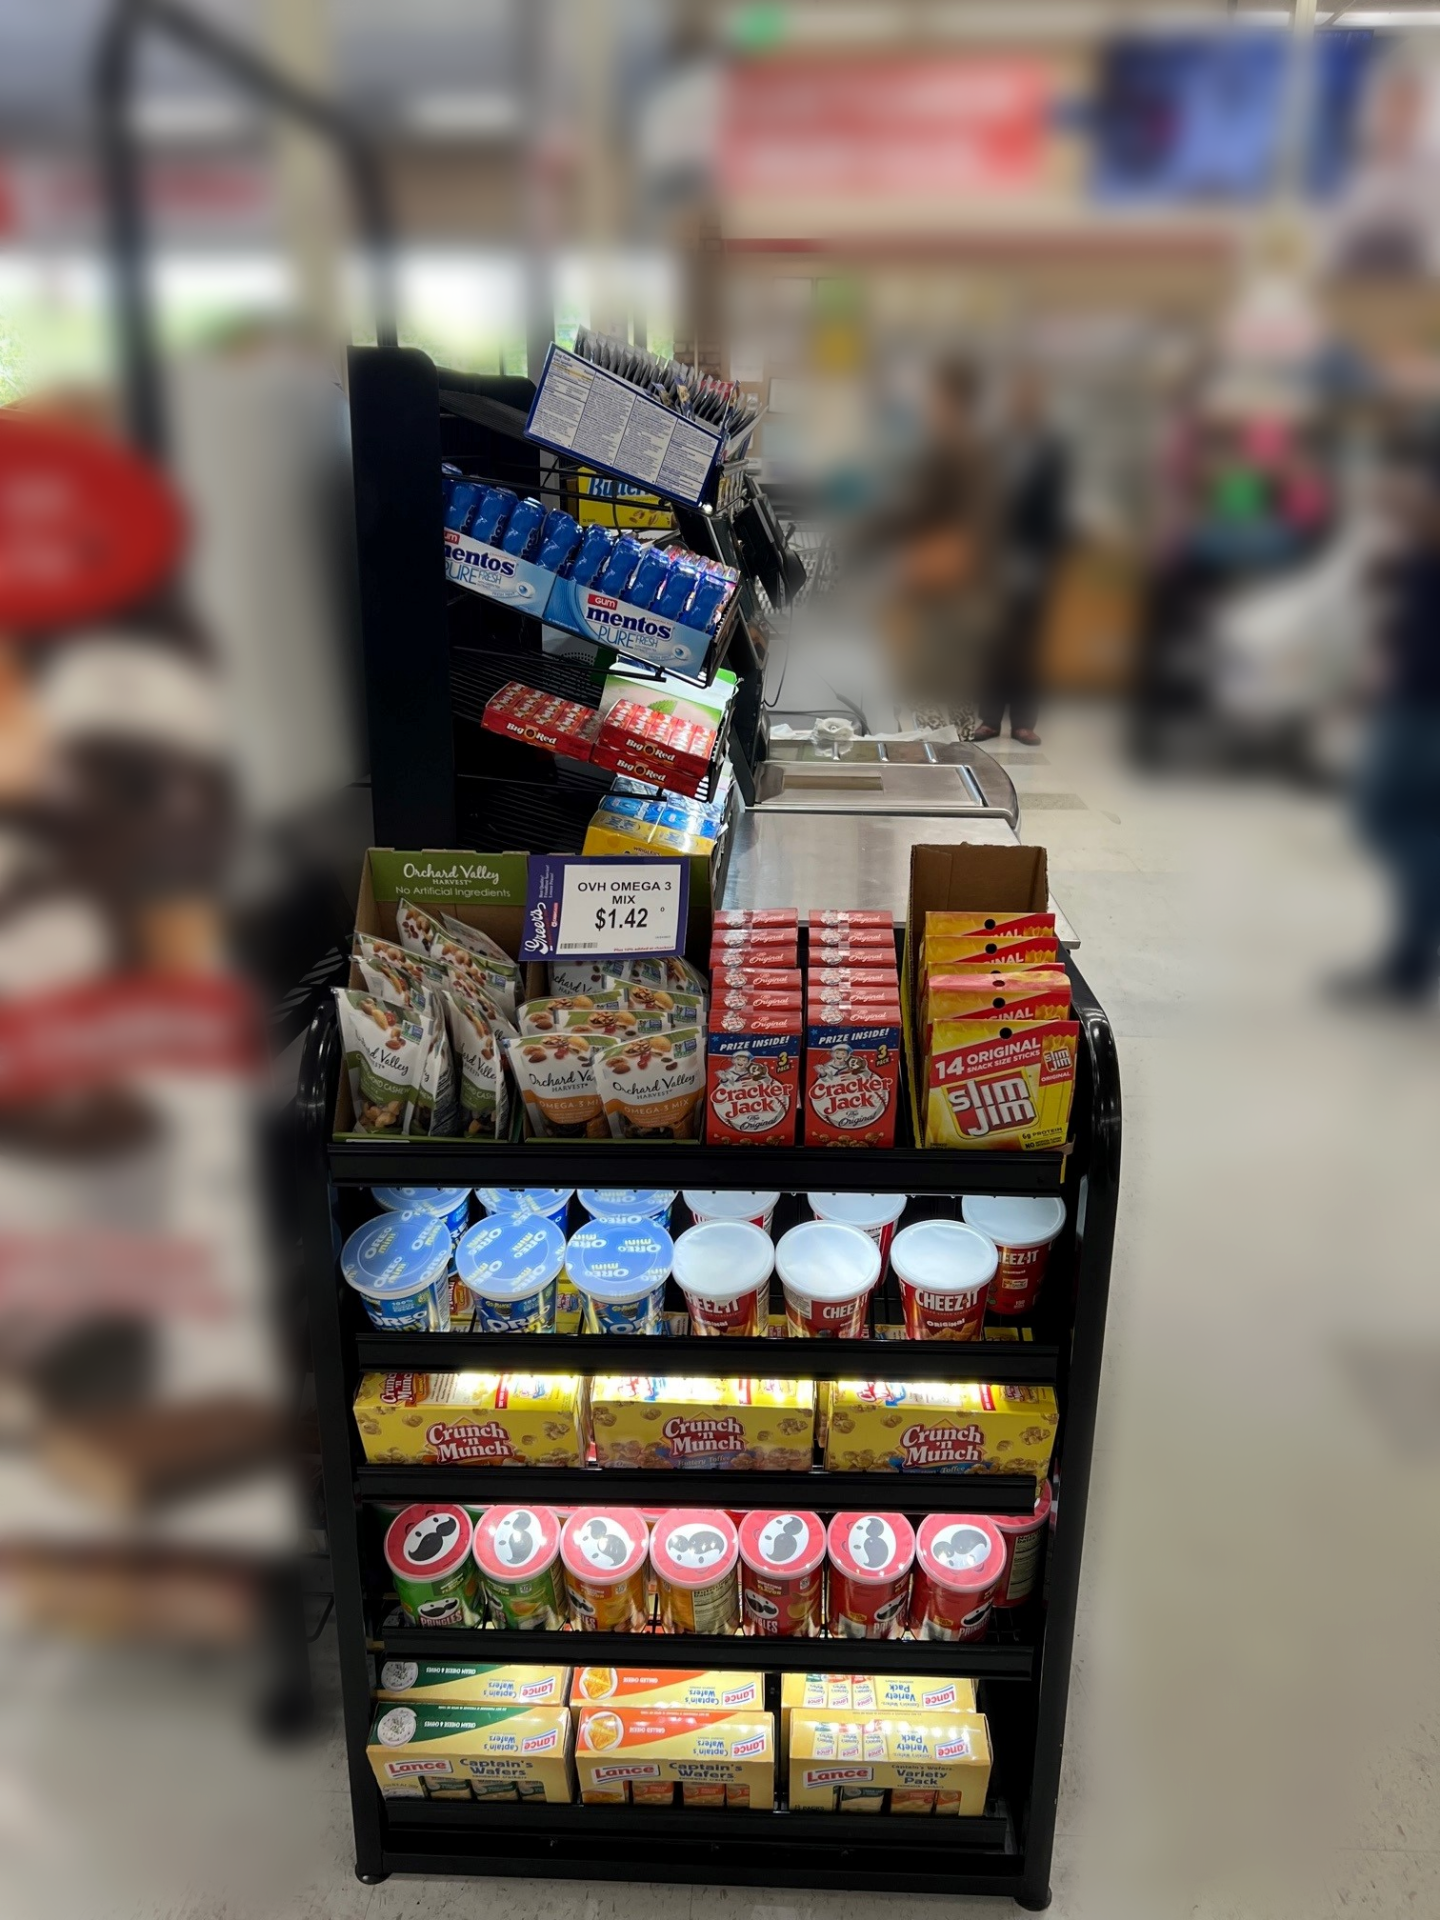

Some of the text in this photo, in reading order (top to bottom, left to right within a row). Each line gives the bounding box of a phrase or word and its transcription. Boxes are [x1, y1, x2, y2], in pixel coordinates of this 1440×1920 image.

[478, 571, 502, 584] FRESH
[586, 606, 671, 639] mentos
[599, 626, 658, 649] PURE FRESH
[506, 722, 557, 745] Big Red
[626, 738, 676, 761] Big Red
[616, 759, 666, 782] Big Red
[403, 863, 500, 885] Orchard Valley
[396, 886, 511, 898] No Artificial Ingredients
[578, 882, 672, 892] OVH OMEGA 3
[612, 895, 636, 904] MIX
[595, 907, 649, 931] $1.42
[524, 902, 549, 955] Greer's
[753, 975, 788, 985] Original
[849, 974, 884, 982] Original
[753, 997, 789, 1007] Original
[850, 992, 885, 1002] Original
[850, 1011, 887, 1021] Original
[750, 1020, 788, 1029] Original
[720, 1036, 790, 1051] PRIZE INSIDE!
[818, 1028, 890, 1045] PRIZE INSIDE!
[878, 1044, 887, 1058] 3
[935, 1037, 1041, 1079] 14 ORIGINAL
[381, 1050, 409, 1076] Valley
[778, 1052, 788, 1066] 3
[967, 1050, 1040, 1073] SNACK SIZE STICKS
[528, 1070, 576, 1087] Orchard
[613, 1073, 695, 1095] Orchard Valley
[1041, 1072, 1071, 1082] ORIGINAL
[552, 1083, 584, 1092] HARVEST
[637, 1090, 670, 1100] HARVEST
[710, 1084, 793, 1104] Cracker
[809, 1077, 893, 1099] Cracker
[672, 1099, 689, 1110] MIX
[725, 1098, 775, 1118] Jack
[824, 1093, 874, 1114] Jack
[740, 1116, 778, 1130] Original
[838, 1112, 877, 1127] Original
[1032, 1127, 1062, 1136] PROTEIN
[601, 1214, 642, 1224] OREO
[365, 1227, 392, 1259] OREO
[378, 1233, 397, 1253] mini
[411, 1220, 438, 1251] OREO
[514, 1230, 547, 1258] OREO
[618, 1244, 662, 1253] OREO
[374, 1256, 403, 1287] OREO
[584, 1268, 629, 1277] OREO
[915, 1288, 979, 1312] CHEEZ-IT
[369, 1310, 427, 1326] OREO
[429, 1423, 506, 1444] Crunch
[665, 1419, 740, 1437] Crunch
[903, 1426, 981, 1447] Crunch
[439, 1441, 509, 1462] Munch
[672, 1436, 742, 1456] Munch
[906, 1446, 979, 1466] Munch
[421, 1610, 462, 1628] PRINGLES
[488, 1682, 514, 1690] Wafers
[522, 1682, 553, 1697] Lance
[889, 1684, 910, 1693] Pack
[483, 1690, 517, 1698] Captain's
[685, 1697, 719, 1705] Captain's
[689, 1690, 715, 1698] Wafers
[724, 1689, 754, 1703] Lance
[885, 1692, 916, 1702] Variety
[925, 1690, 955, 1705] Lance
[489, 1735, 516, 1744] Wafers
[524, 1734, 556, 1751] Lance
[697, 1740, 724, 1748] Wafers
[901, 1734, 923, 1744] Pack
[484, 1743, 518, 1752] Captain's
[693, 1748, 728, 1756] Captain's
[733, 1740, 764, 1756] Lance
[896, 1743, 928, 1753] Variety
[389, 1758, 533, 1774] Lance Captain's
[470, 1767, 526, 1776] Wafers
[595, 1763, 742, 1779] Lance Captain's
[678, 1770, 734, 1778] Wafers
[807, 1769, 947, 1783] Lance Variety
